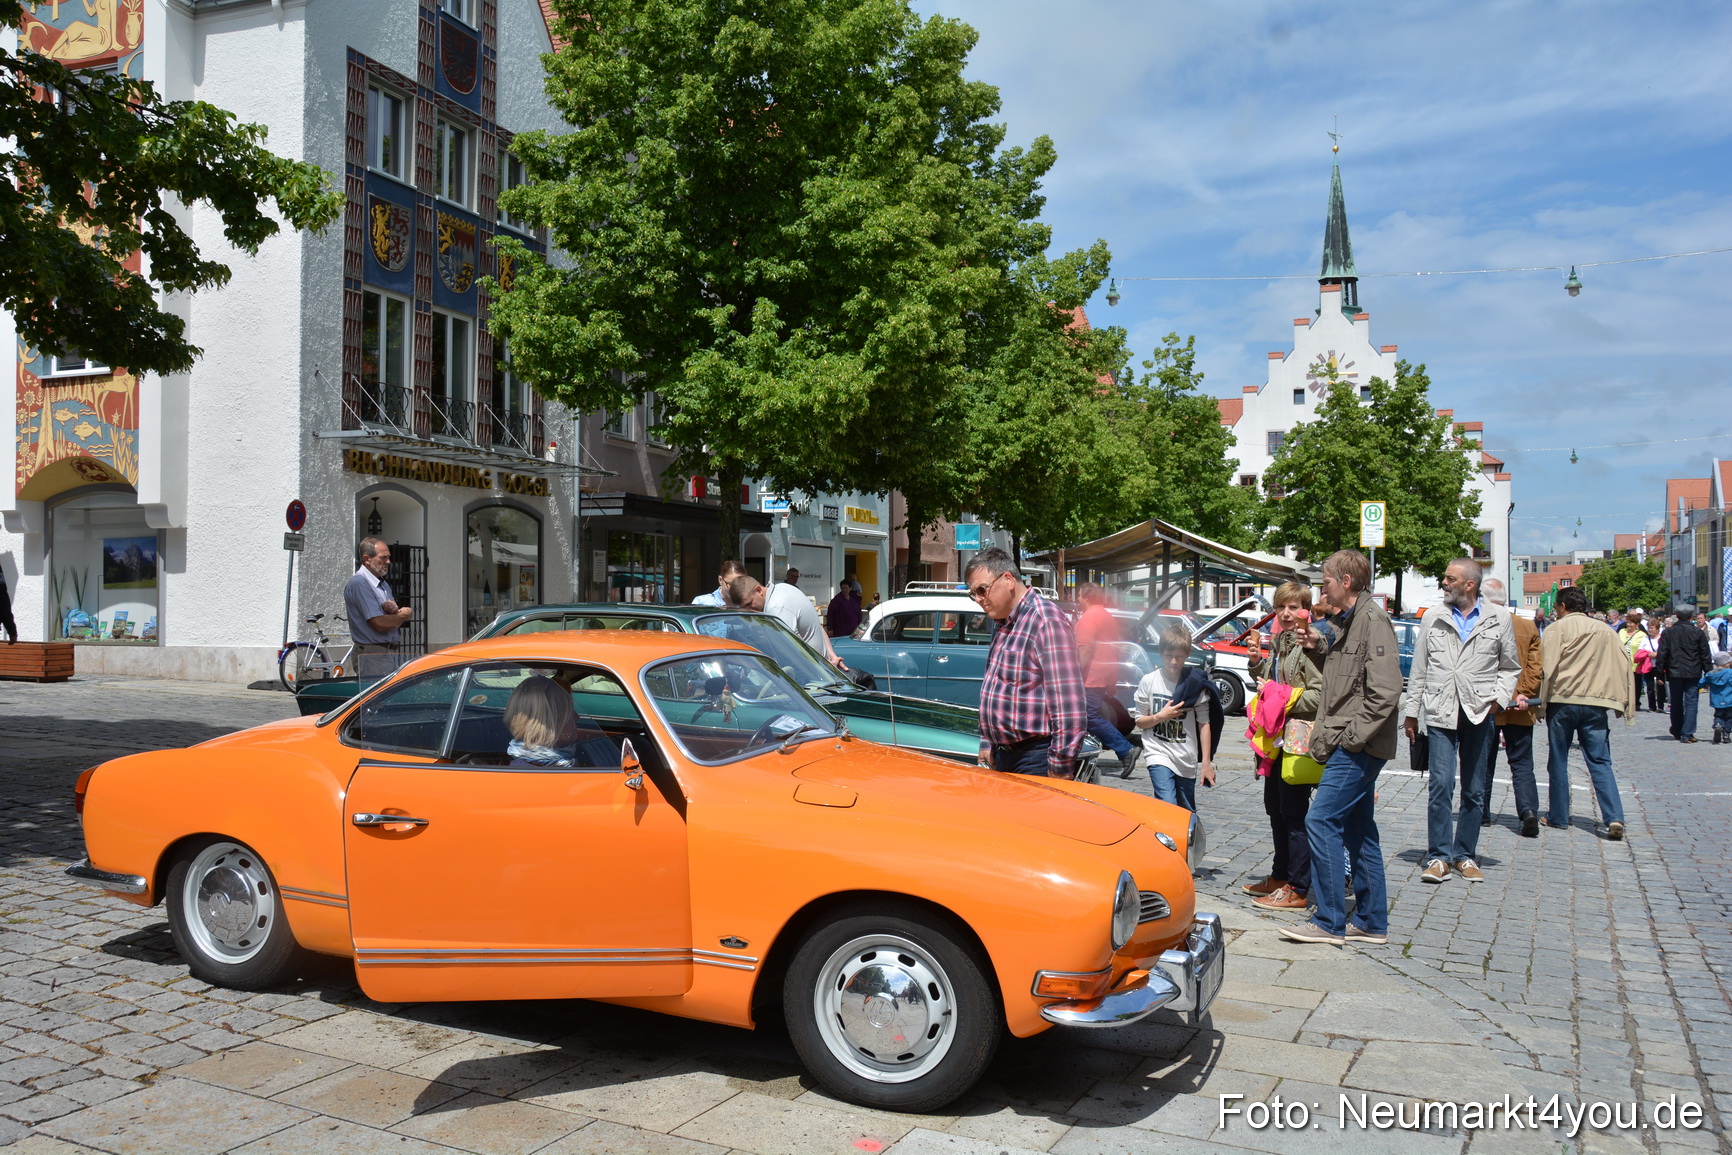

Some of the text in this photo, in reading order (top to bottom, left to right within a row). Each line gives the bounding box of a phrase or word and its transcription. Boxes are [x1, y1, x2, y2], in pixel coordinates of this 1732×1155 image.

[348, 448, 552, 497] BUCHHANDLUNG BOEGL
[706, 481, 721, 496] Stre
